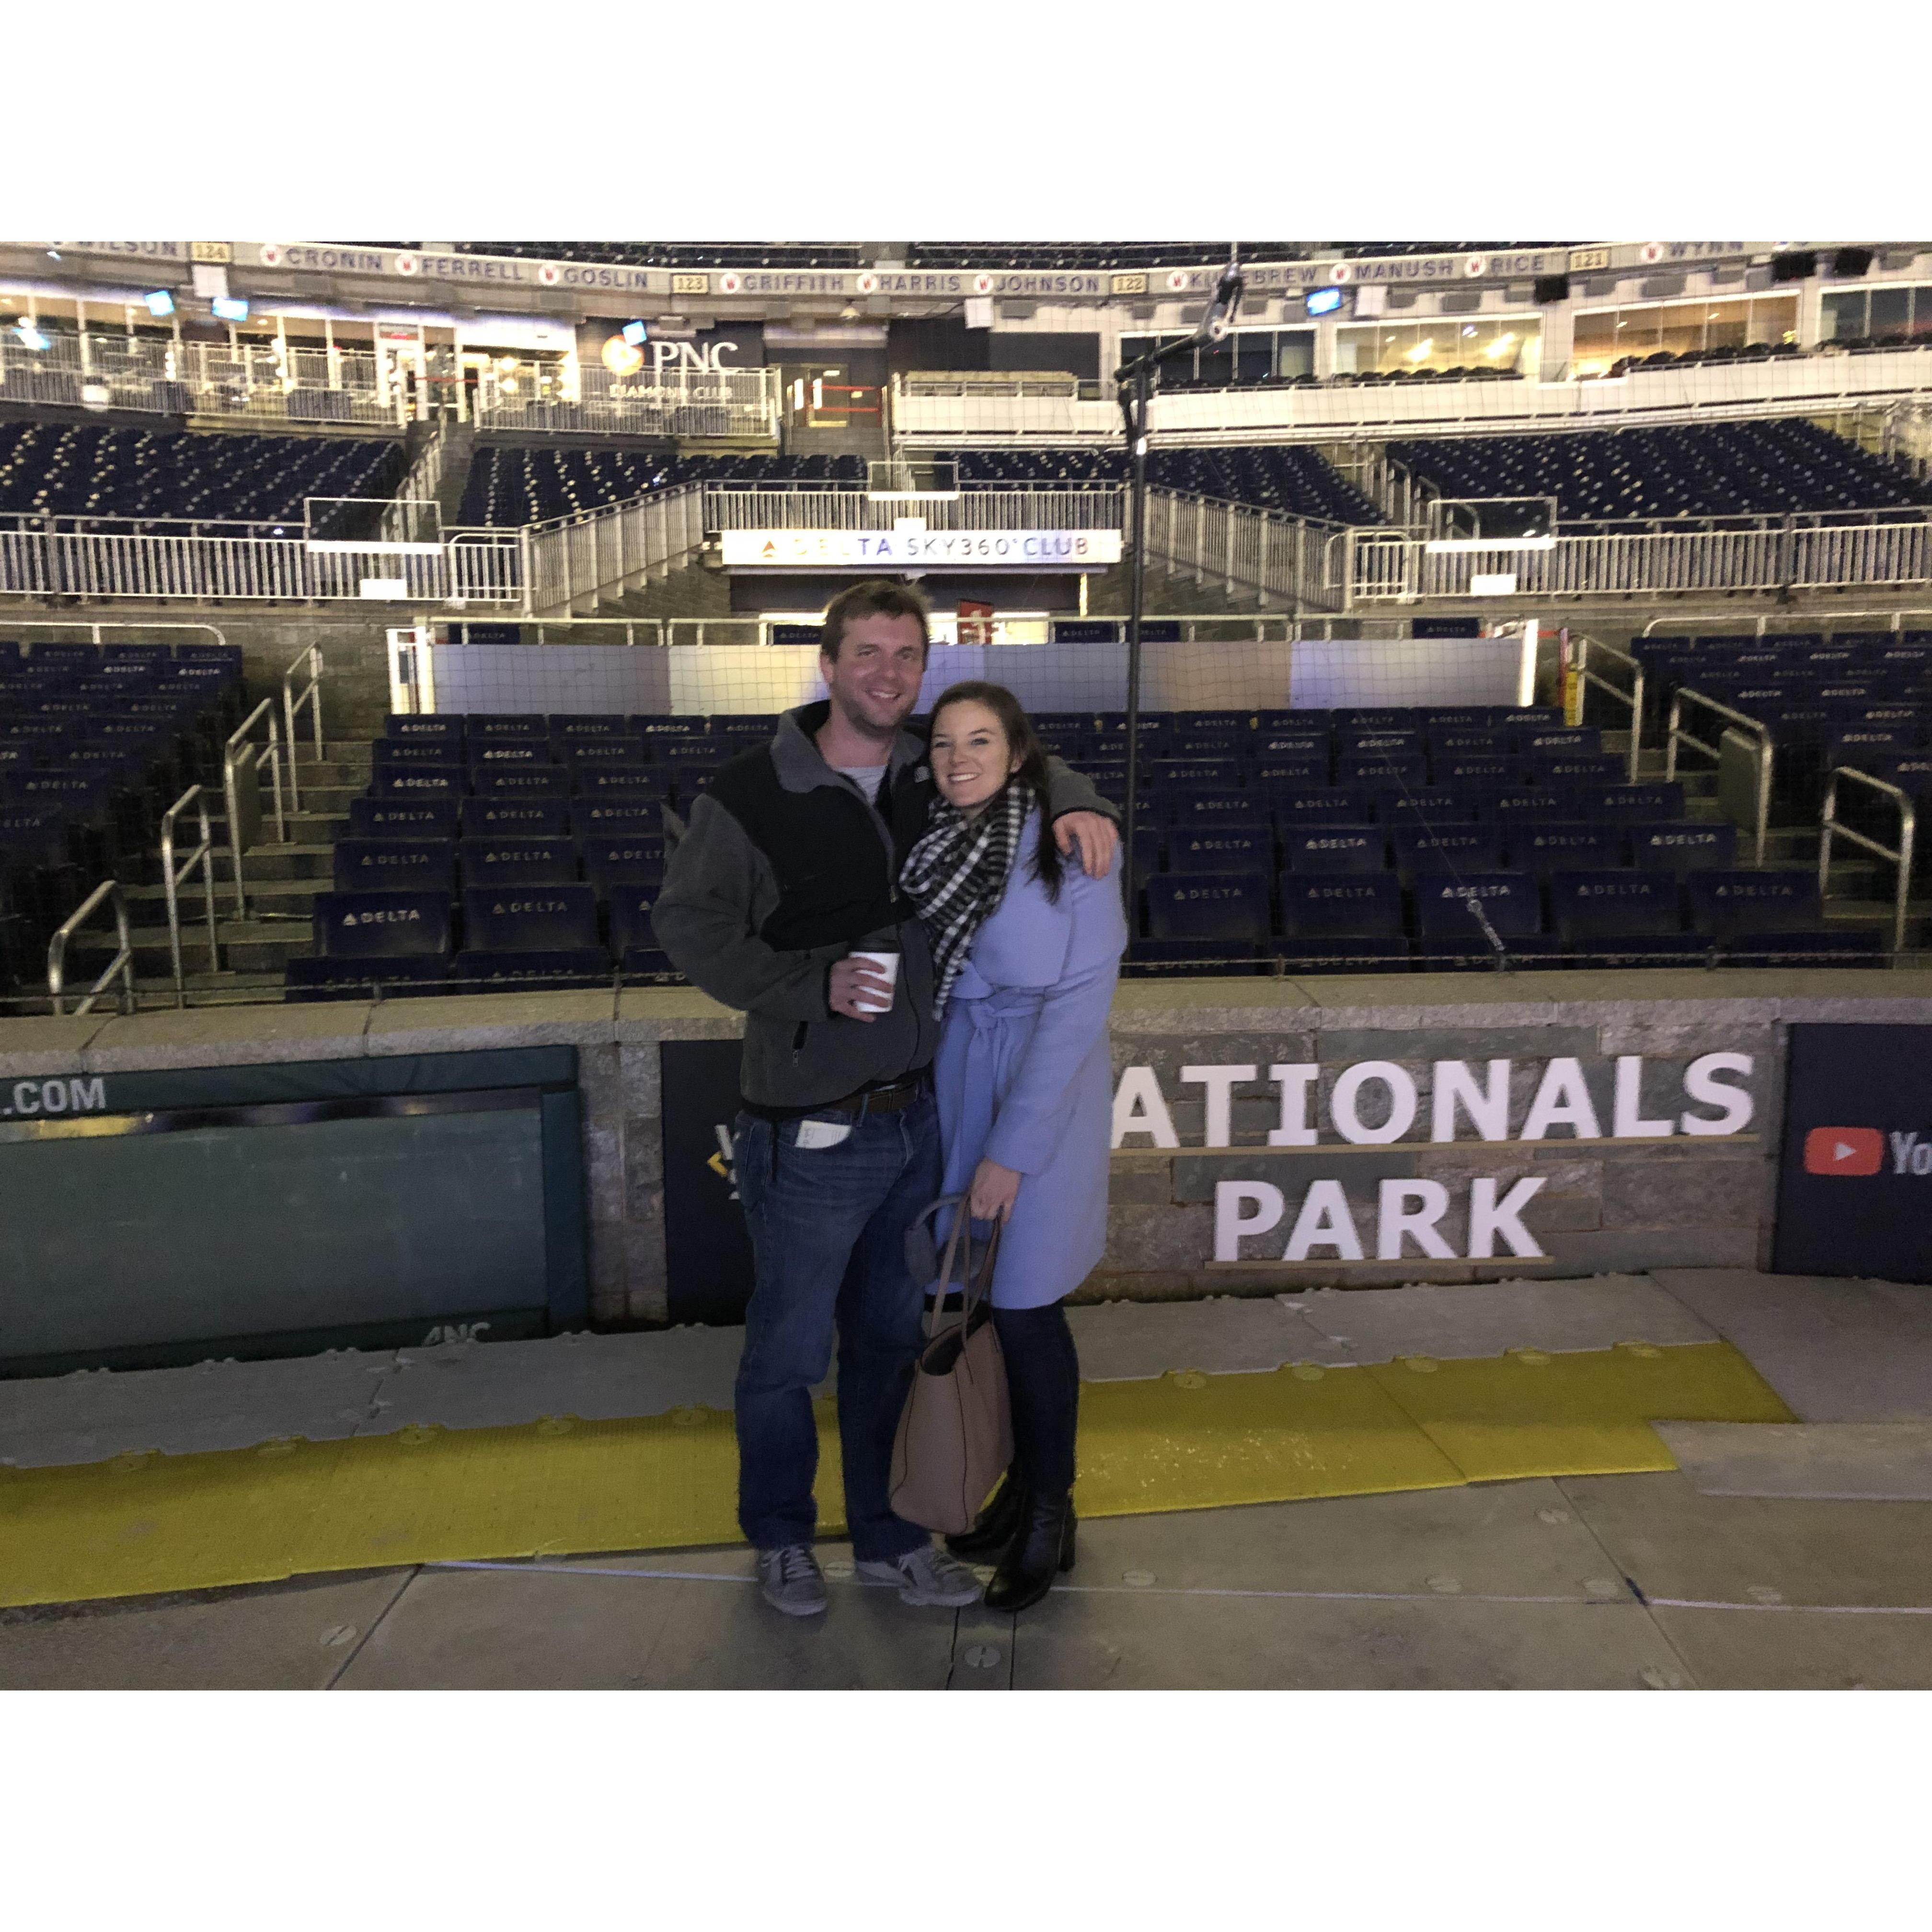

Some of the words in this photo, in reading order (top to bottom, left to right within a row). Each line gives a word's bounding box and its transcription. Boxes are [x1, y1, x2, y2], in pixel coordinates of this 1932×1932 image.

[286, 248, 382, 269] CRONIN
[1491, 255, 1544, 273] RICE
[1574, 253, 1603, 266] 121
[422, 258, 526, 280] FERRELL
[1356, 260, 1454, 279] MANUSH
[564, 268, 648, 288] GOSLIN
[678, 277, 703, 290] 123
[743, 276, 844, 291] GRIFFITH
[880, 275, 959, 291] HARRIS
[995, 275, 1101, 293] JOHNSON
[1117, 277, 1143, 291] 122
[650, 341, 738, 375] PNC
[1024, 537, 1089, 556] CLUB
[406, 778, 448, 787] DELTA
[509, 777, 549, 785] DELTA
[1208, 801, 1249, 810] DELTA
[1308, 799, 1348, 808] DELTA
[388, 812, 434, 820] DELTA
[500, 811, 544, 819] DELTA
[1318, 838, 1367, 849] DELTA
[1430, 837, 1478, 847] DELTA
[1549, 836, 1597, 846] DELTA
[1667, 833, 1716, 845] DELTA
[1205, 840, 1252, 850] DELTA
[378, 854, 428, 864] DELTA
[500, 851, 552, 861] DELTA
[623, 850, 665, 861] DELT
[1189, 888, 1242, 899] DELTA
[1324, 887, 1376, 898] DELTA
[1457, 886, 1510, 897] DELTA
[1595, 884, 1651, 895] DELTA
[1733, 886, 1794, 896] DELTA
[510, 902, 568, 913] DELTA
[360, 909, 421, 923] DELTA
[3, 1078, 106, 1115] .COM
[1111, 1052, 1754, 1149] ATIONALS
[1889, 1131, 1932, 1175] Yo
[1214, 1176, 1546, 1262] PARK
